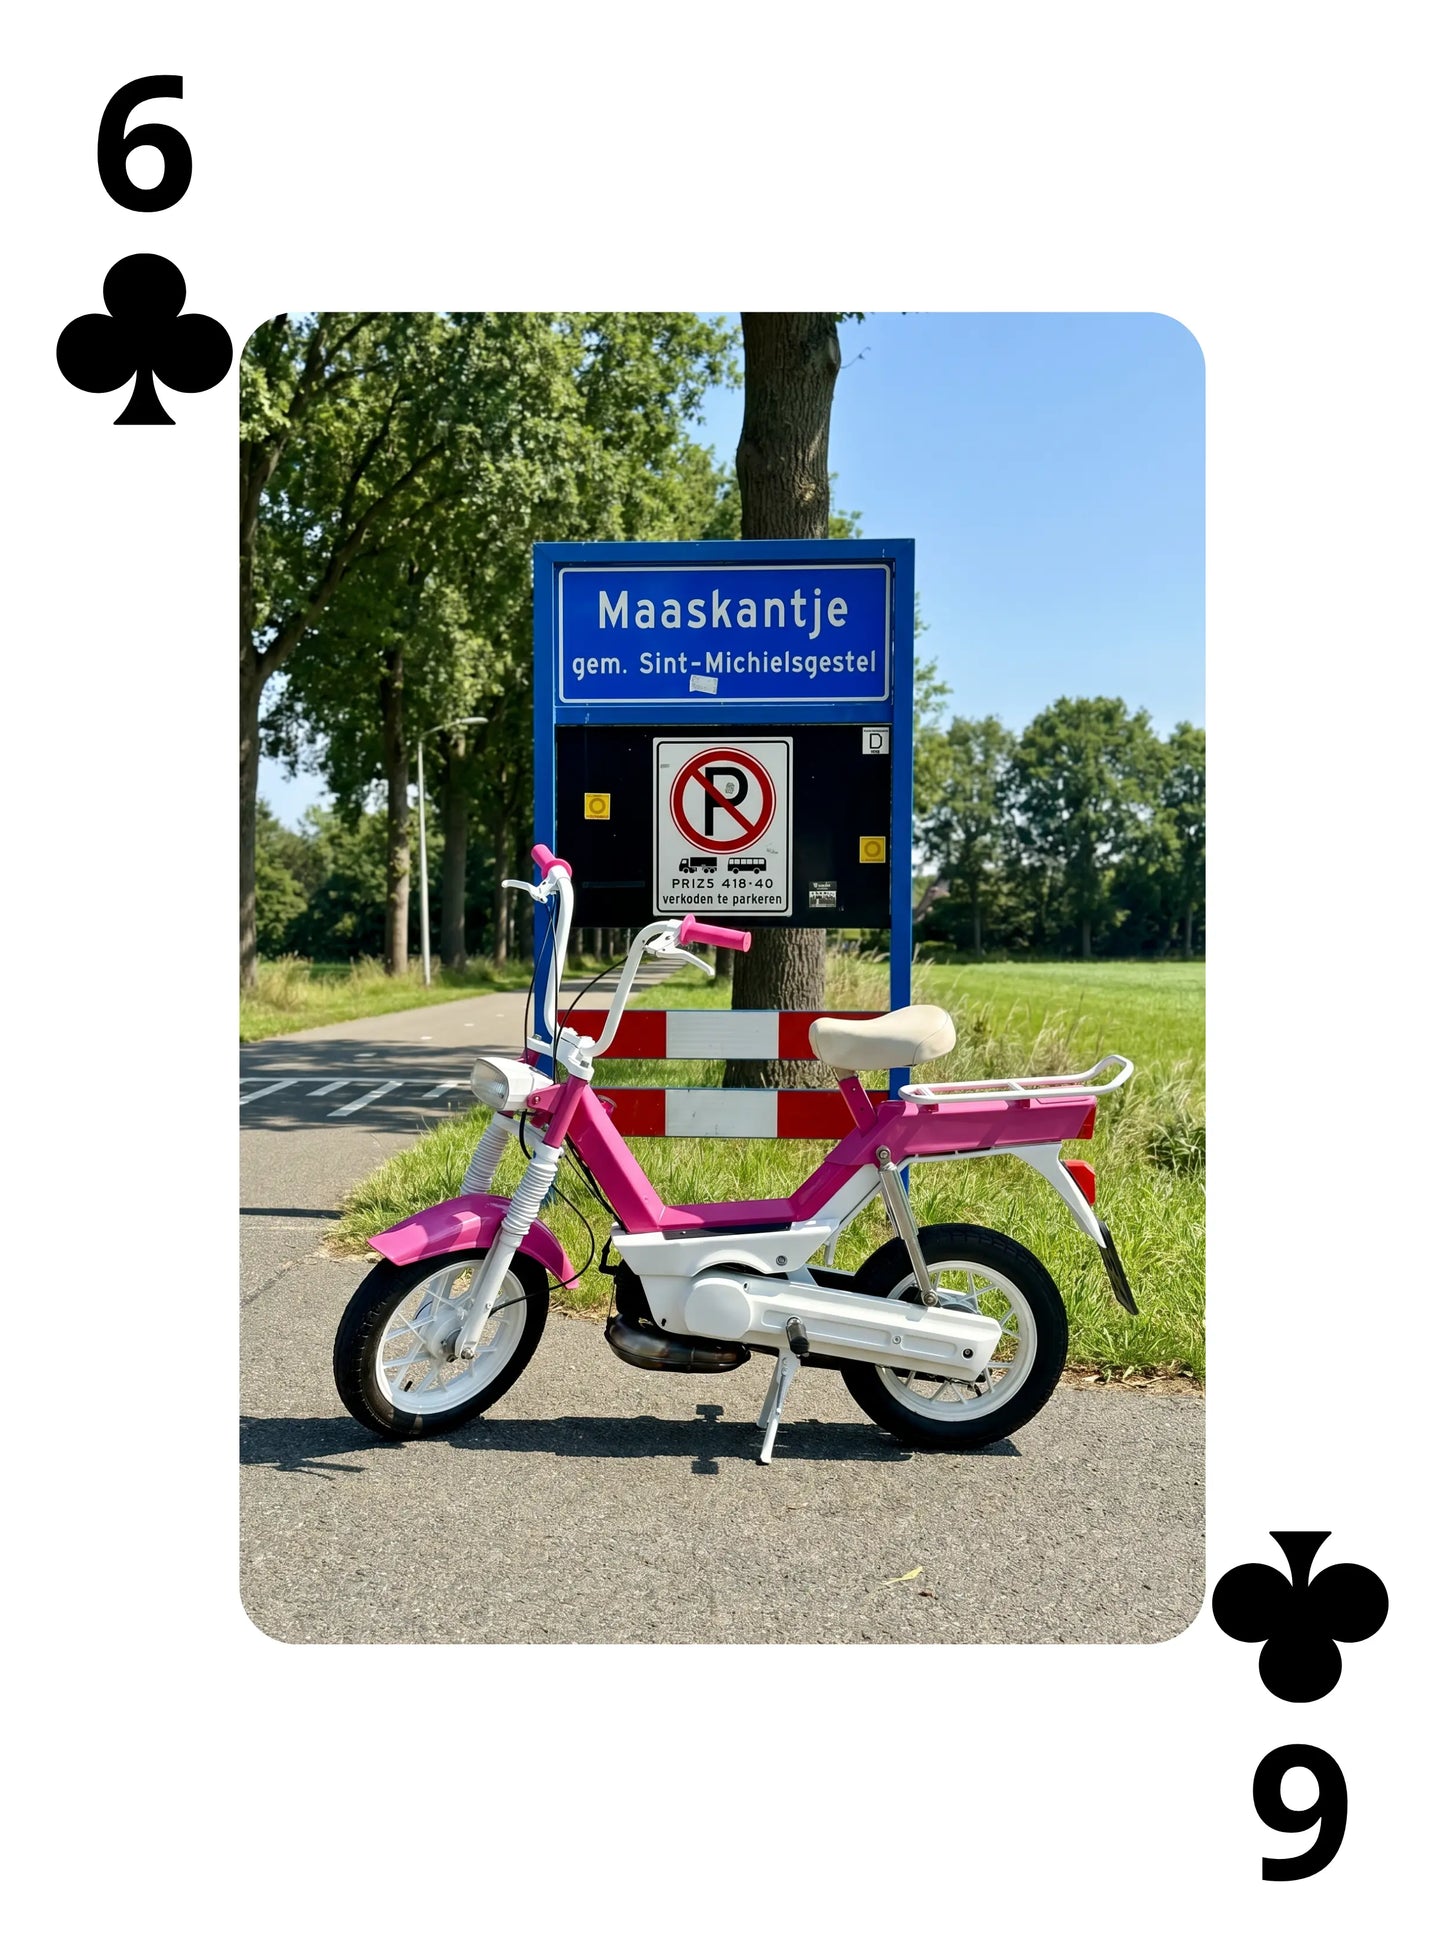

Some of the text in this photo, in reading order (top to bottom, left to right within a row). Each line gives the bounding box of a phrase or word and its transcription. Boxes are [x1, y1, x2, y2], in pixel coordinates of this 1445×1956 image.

[599, 588, 848, 638] Maaskantje
[572, 650, 876, 681] gem. Sint-Michielsgestel
[869, 733, 883, 749] D
[705, 767, 748, 836] P
[662, 893, 782, 907] verkoden te parkeren
